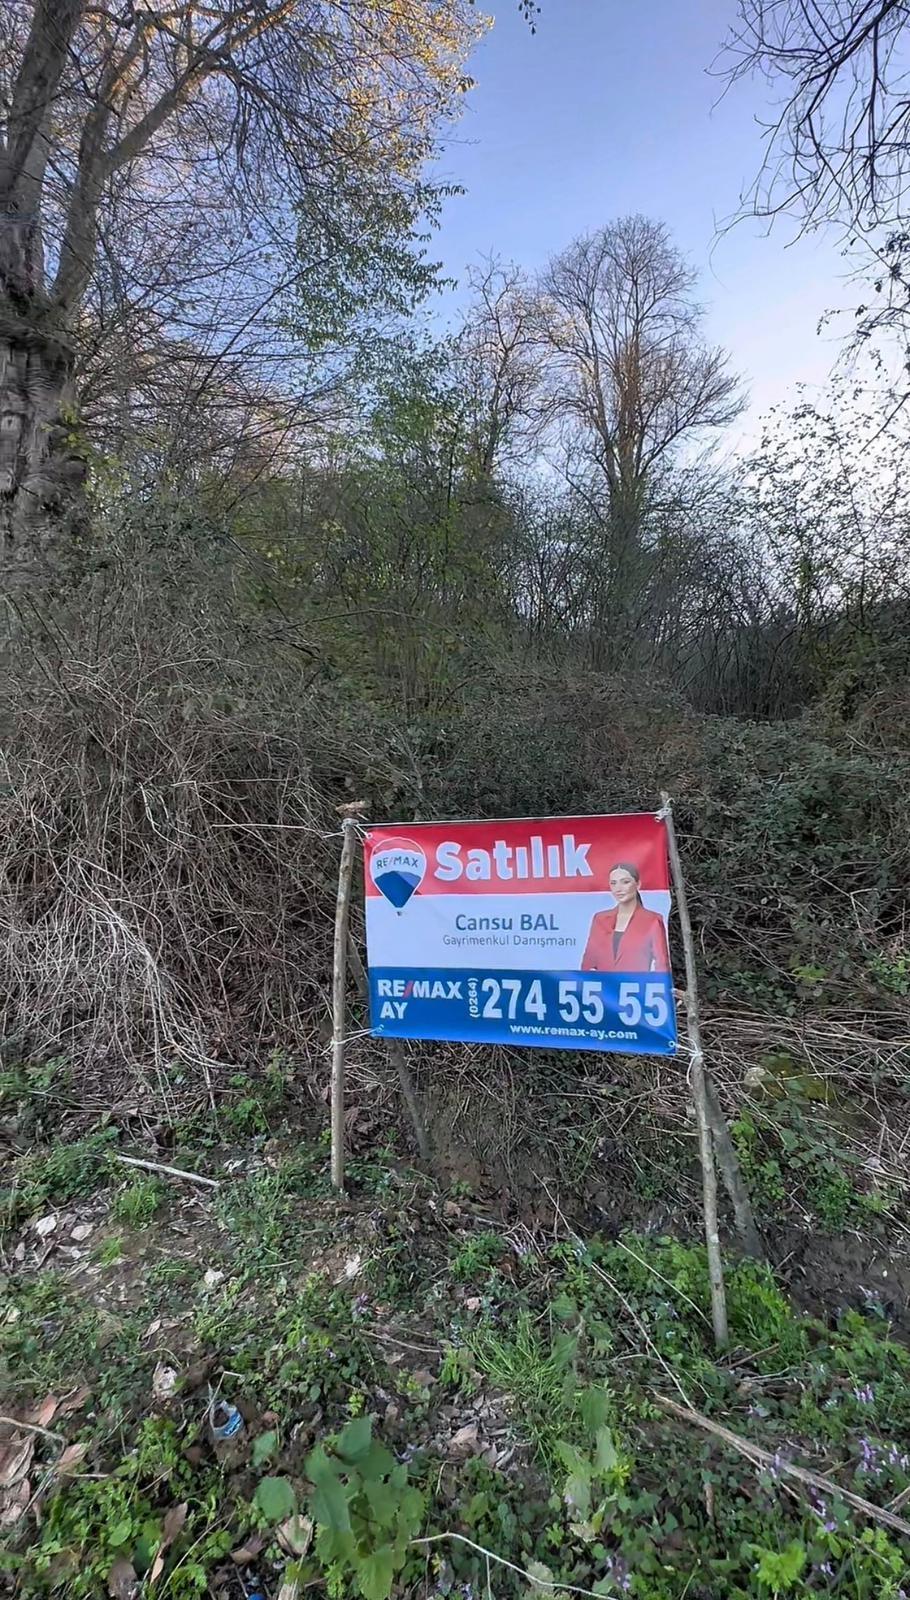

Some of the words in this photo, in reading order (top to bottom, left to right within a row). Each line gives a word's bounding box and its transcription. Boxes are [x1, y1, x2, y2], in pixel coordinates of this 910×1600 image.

[376, 855, 419, 869] RE/MAX
[433, 834, 595, 881] Satılık
[455, 914, 513, 931] Cansu
[520, 914, 559, 931] BAL
[442, 934, 510, 949] Gayrimenkul
[513, 935, 577, 949] Danışmanı
[377, 980, 463, 1000] RE/MAX
[380, 1002, 408, 1019] AY
[468, 978, 481, 1018] (0264)
[482, 978, 547, 1021] 274
[558, 980, 605, 1024] 55
[618, 982, 666, 1026] 55
[510, 1023, 638, 1040] www.remax-ay.com
